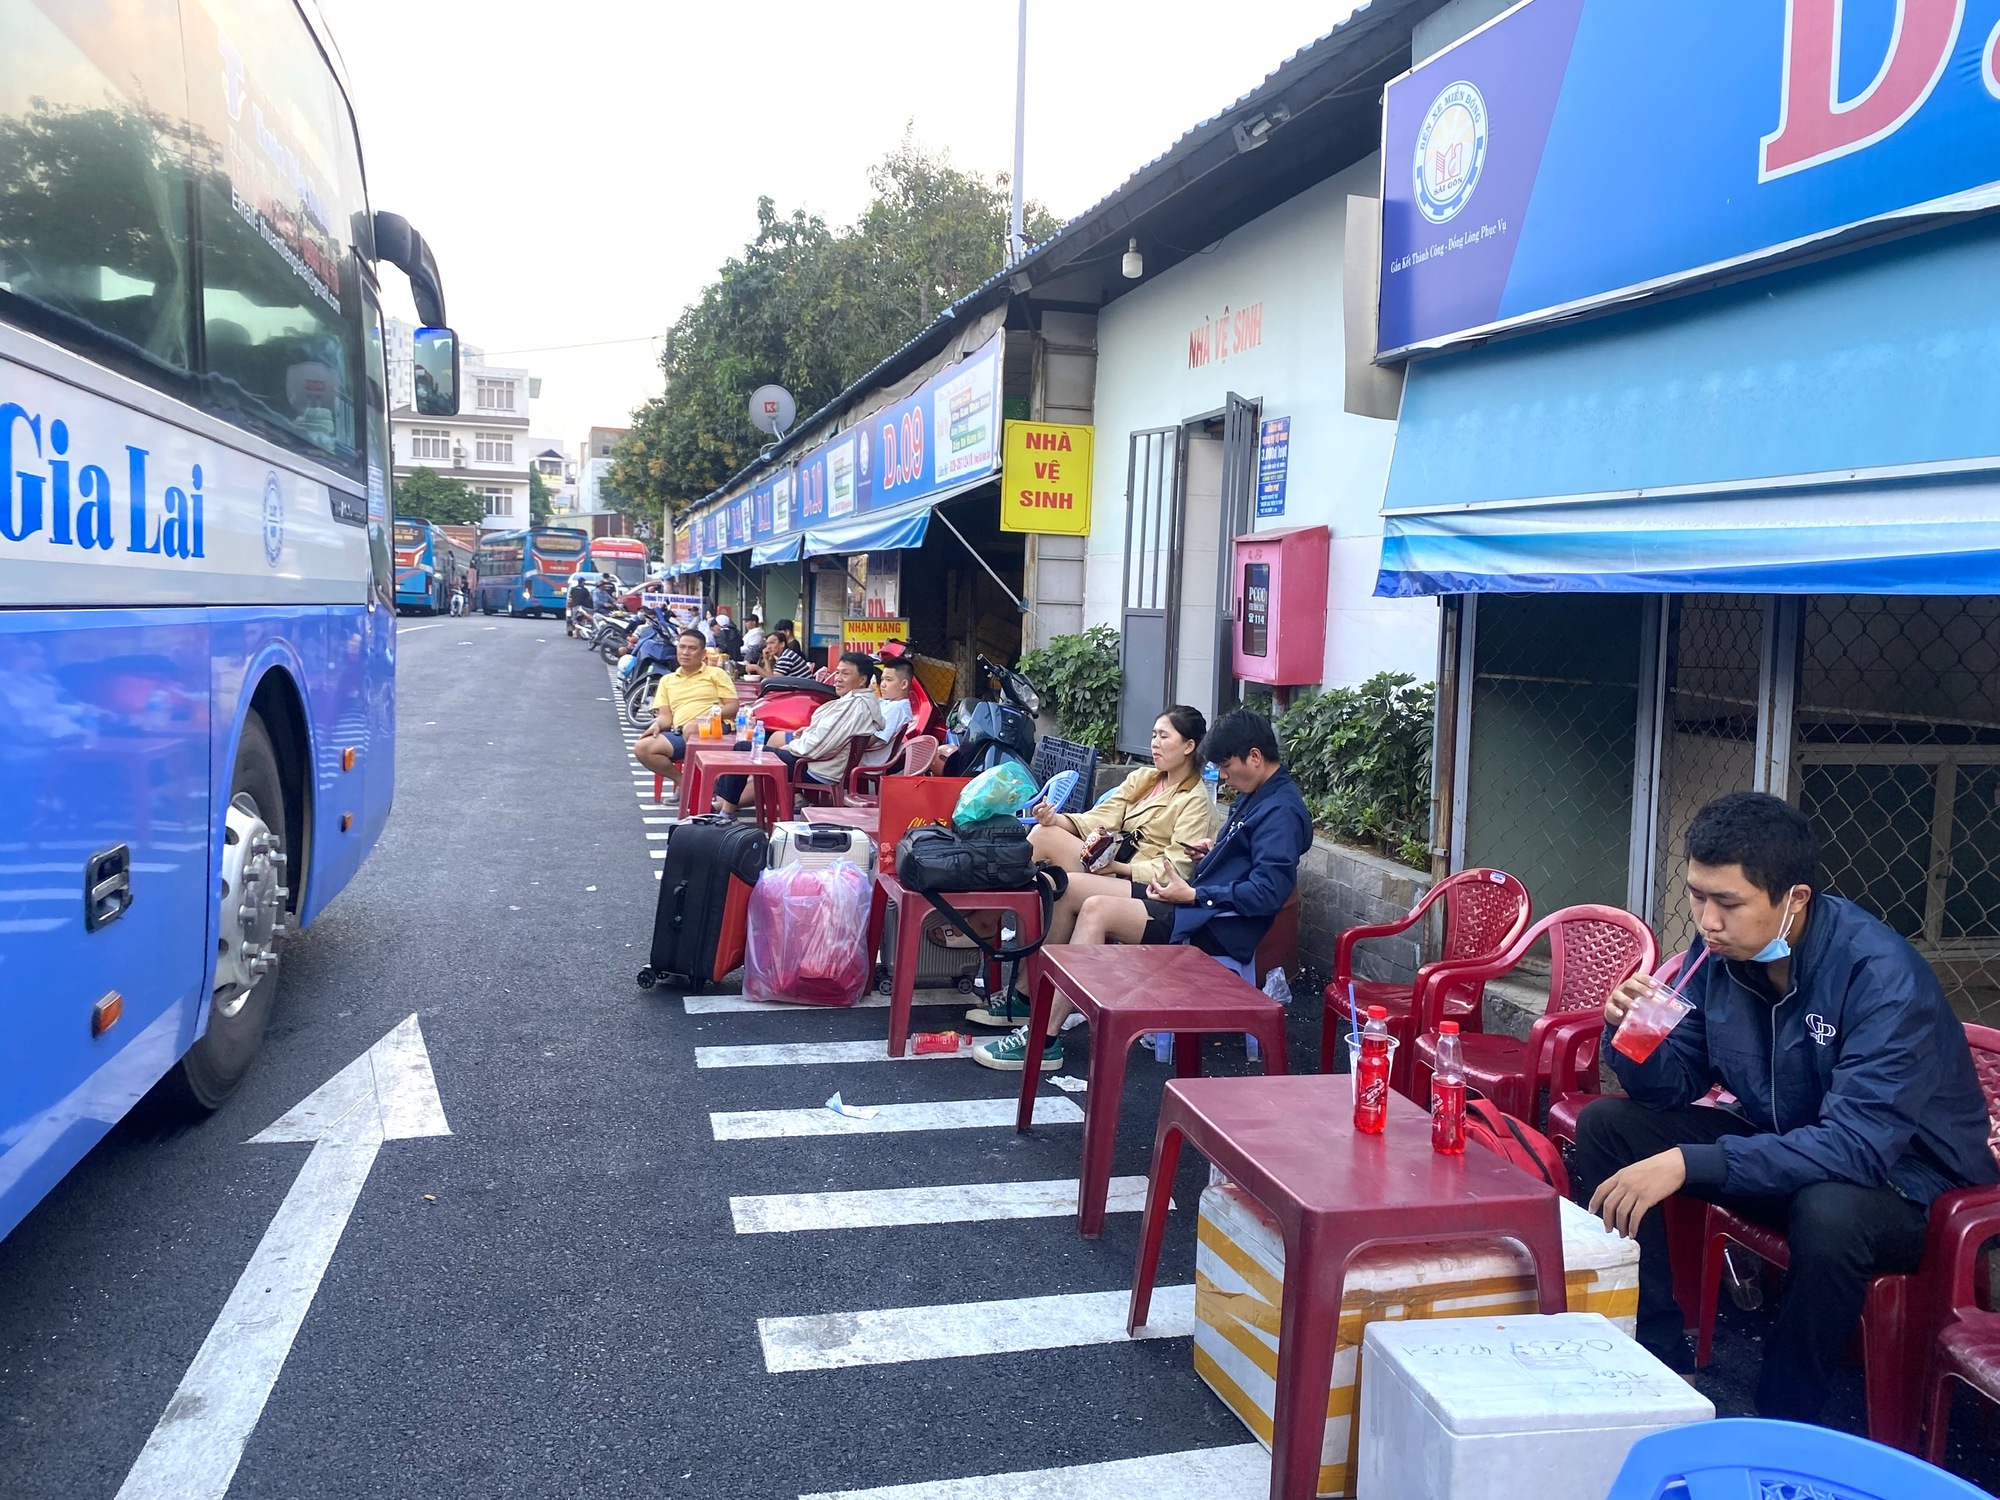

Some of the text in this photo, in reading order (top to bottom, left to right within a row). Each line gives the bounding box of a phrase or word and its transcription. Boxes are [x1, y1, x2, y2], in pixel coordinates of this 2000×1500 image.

[1188, 301, 1263, 370] NHÀ VỆ SINH
[883, 405, 924, 490] D.09
[1026, 431, 1072, 452] NHÀ
[0, 402, 114, 551] Gia
[125, 444, 205, 560] Lai
[1034, 459, 1061, 484] VỆ
[1019, 490, 1073, 509] SINH
[1248, 586, 1266, 602] PCCC
[848, 620, 901, 636] NHẬN HÀNG
[1254, 614, 1265, 625] 114
